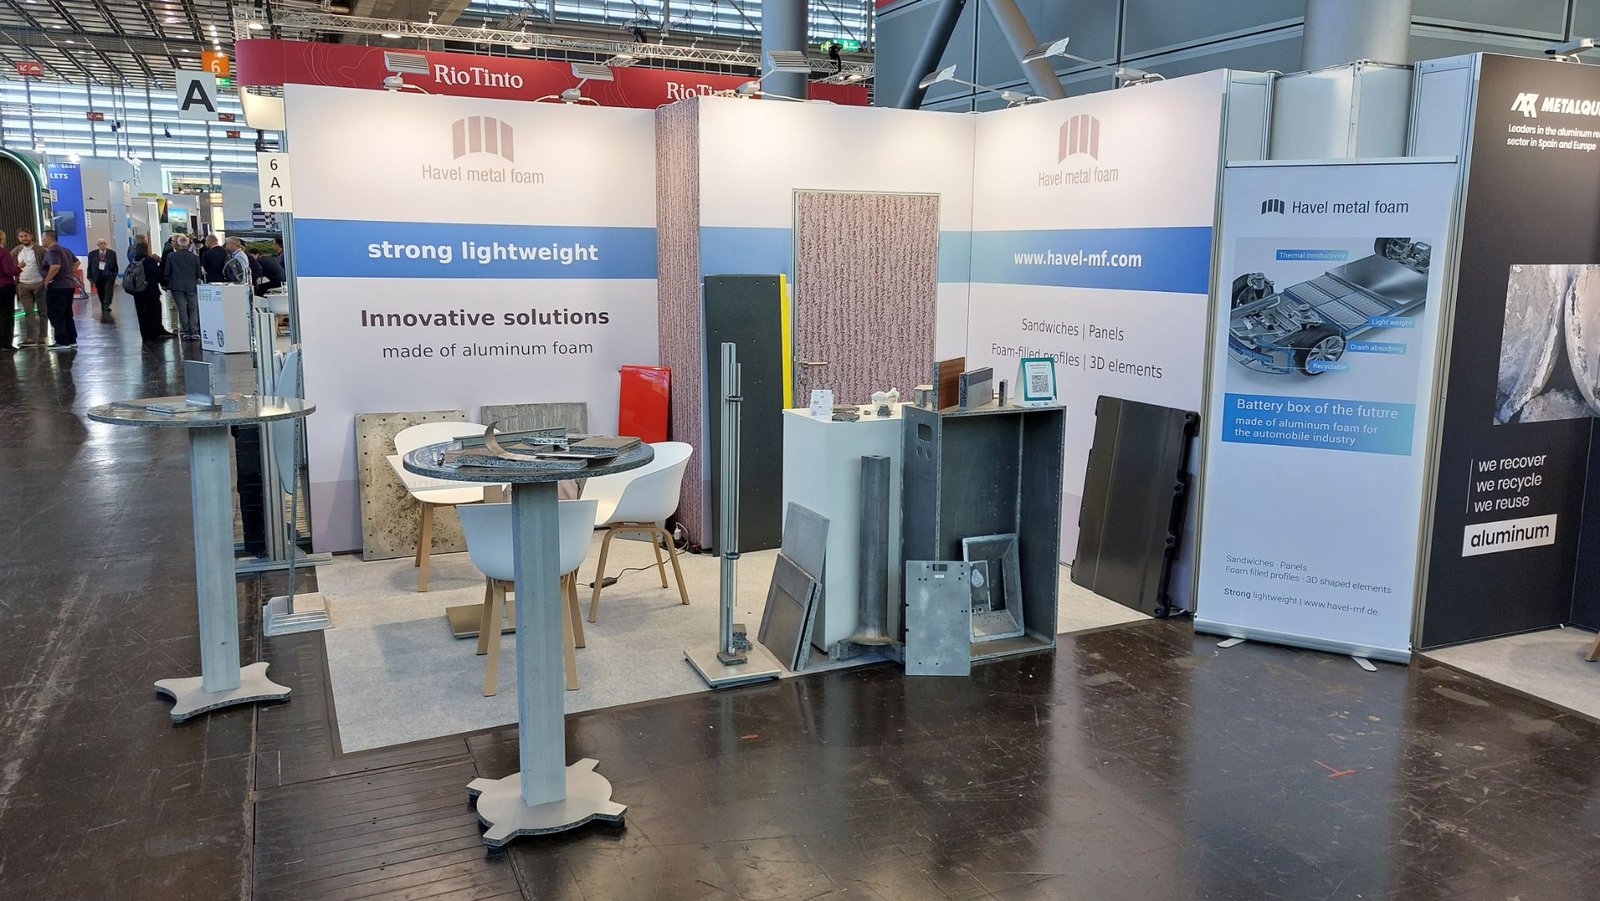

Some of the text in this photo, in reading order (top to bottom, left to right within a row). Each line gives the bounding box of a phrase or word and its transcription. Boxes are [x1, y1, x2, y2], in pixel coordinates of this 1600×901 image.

[211, 60, 221, 73] 6
[181, 79, 216, 113] A
[1541, 97, 1600, 116] METALQU
[1508, 124, 1536, 134] Leaders
[1537, 125, 1544, 134] in
[1545, 126, 1556, 135] the
[1557, 127, 1592, 138] aluminum
[1507, 137, 1597, 152] sector in Spain and Europe
[270, 158, 278, 171] 6
[271, 177, 281, 188] A
[422, 164, 545, 184] Havel metal foam
[1038, 167, 1119, 187] Havel metal foam
[269, 195, 283, 207] 61
[1292, 200, 1409, 214] Havel metal foam
[368, 240, 598, 265] strong lightweight
[1014, 250, 1142, 268] www.havel-mf.com
[361, 308, 609, 327] Innovative solutions
[1371, 318, 1389, 327] Light
[1022, 318, 1124, 341] Sandwiches Panels
[383, 341, 593, 358] made of aluminum foam
[1370, 345, 1403, 353] absorbing
[992, 343, 1041, 359] Foam-filled
[1090, 355, 1105, 370] 3D
[1108, 359, 1162, 379] elements
[1312, 362, 1347, 371] Recyclable
[1237, 399, 1398, 419] Battery box of the future
[1235, 417, 1378, 434] made of aluminum foam for
[1235, 428, 1356, 447] the automobile industry
[1478, 454, 1547, 472] we recover
[1476, 473, 1542, 493] we recycle
[1474, 495, 1530, 513] we reuse
[1470, 524, 1549, 548] aluminum
[1226, 555, 1307, 572] Sandwiches Panels
[1225, 566, 1392, 594] Foam filled profiles 3D shaped elements
[1224, 588, 1378, 616] Strong lightweight www.havel-mf.de
